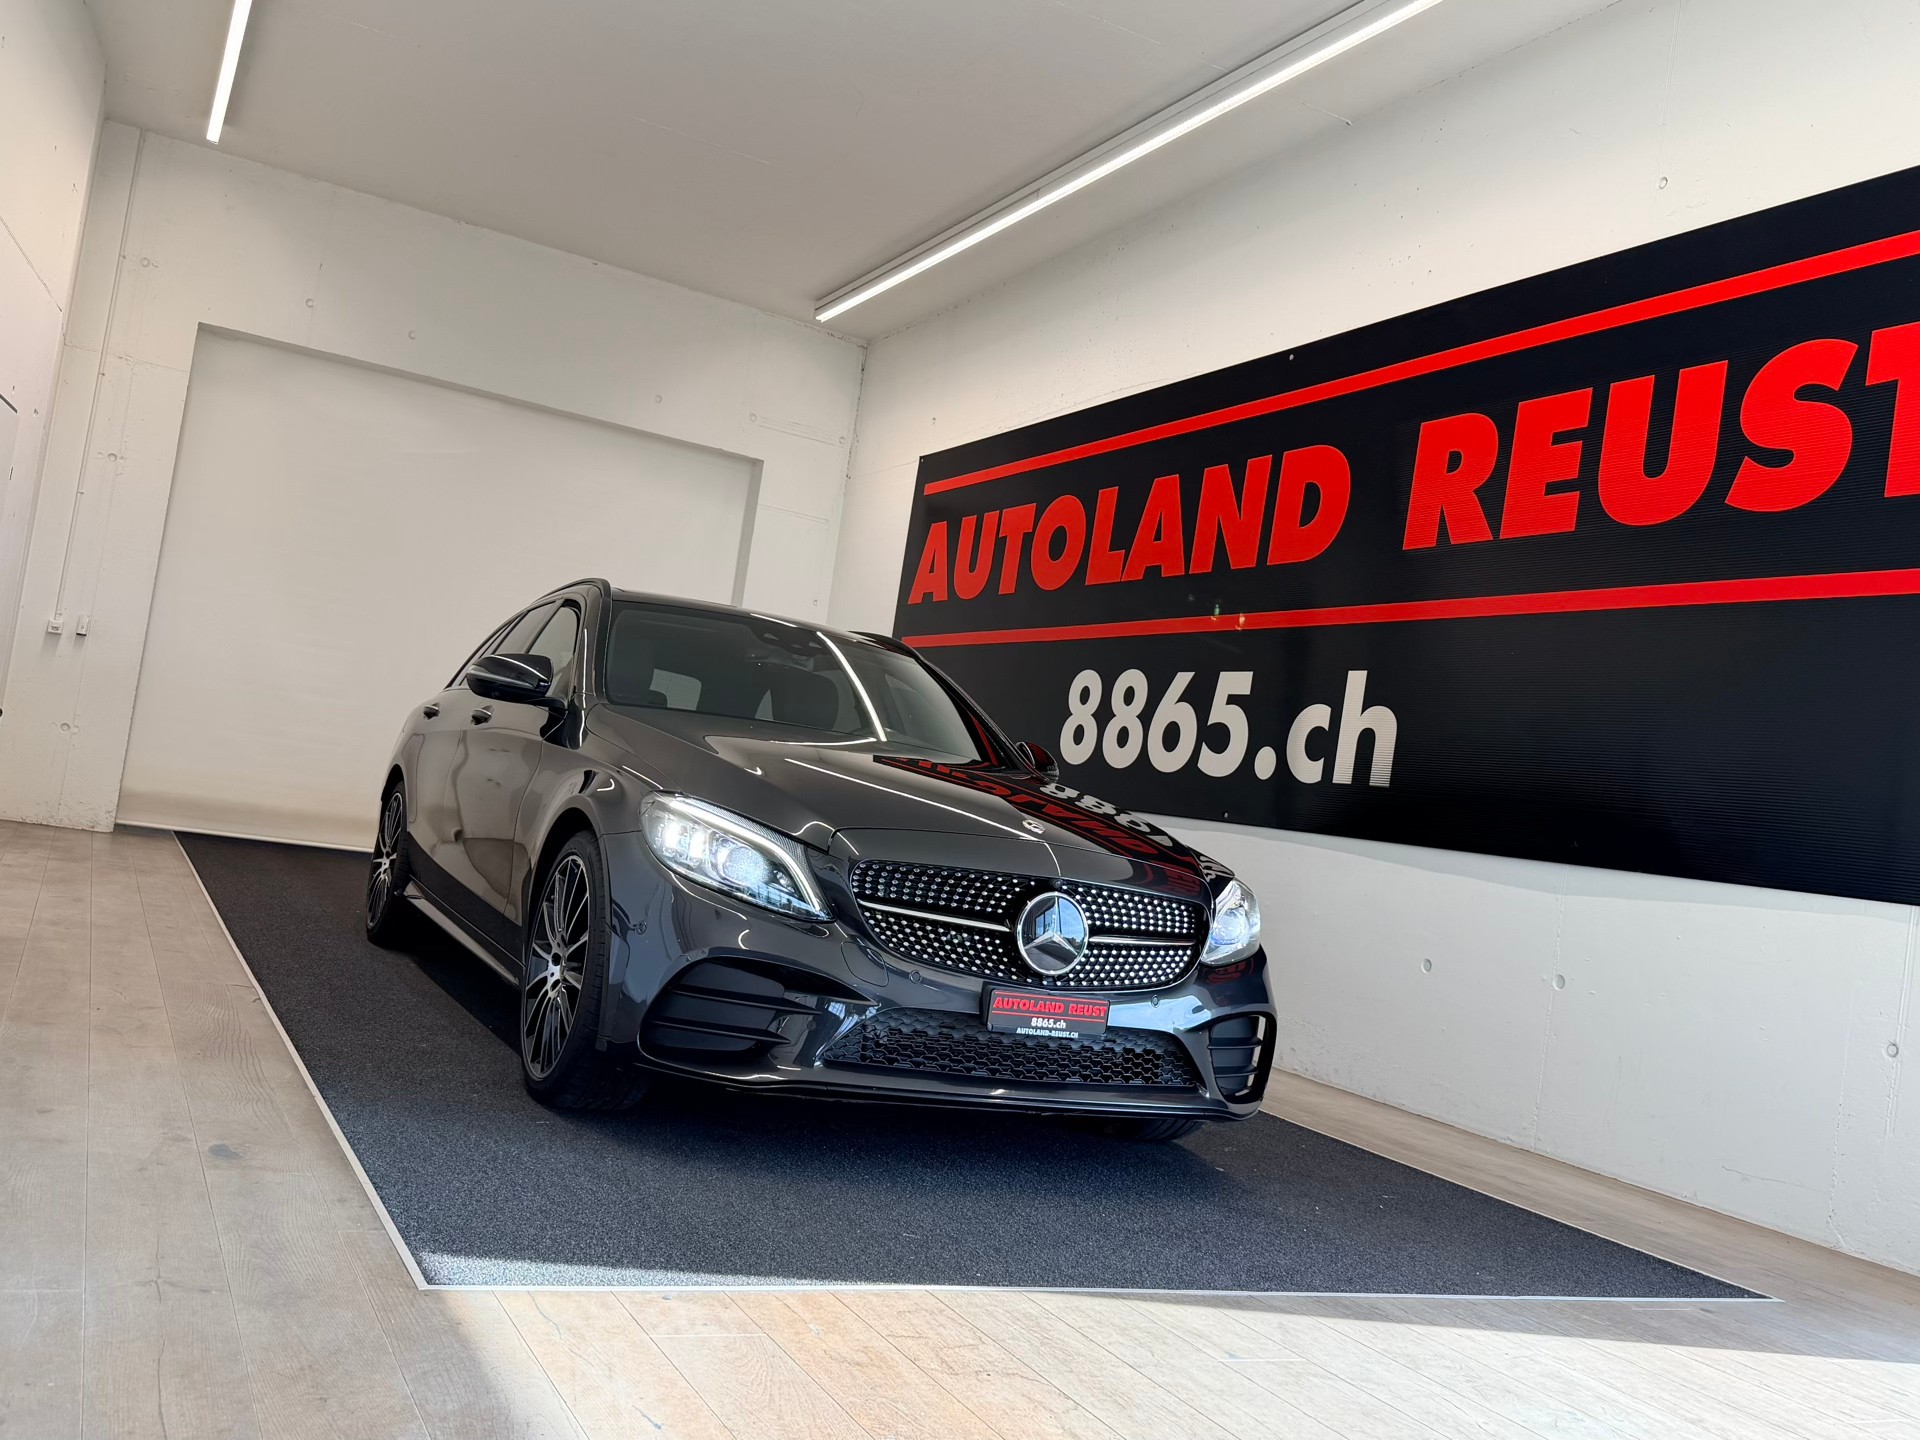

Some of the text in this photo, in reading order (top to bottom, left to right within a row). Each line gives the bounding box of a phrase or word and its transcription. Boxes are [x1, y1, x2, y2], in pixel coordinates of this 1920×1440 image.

[908, 445, 1351, 605] AUTOLAND
[1060, 669, 1398, 788] 8865.ch
[993, 997, 1107, 1017] AUTOLAND REUST
[1016, 1027, 1079, 1039] AUTOLAND-REUST.CH
[1031, 1017, 1066, 1029] 8865.ch
